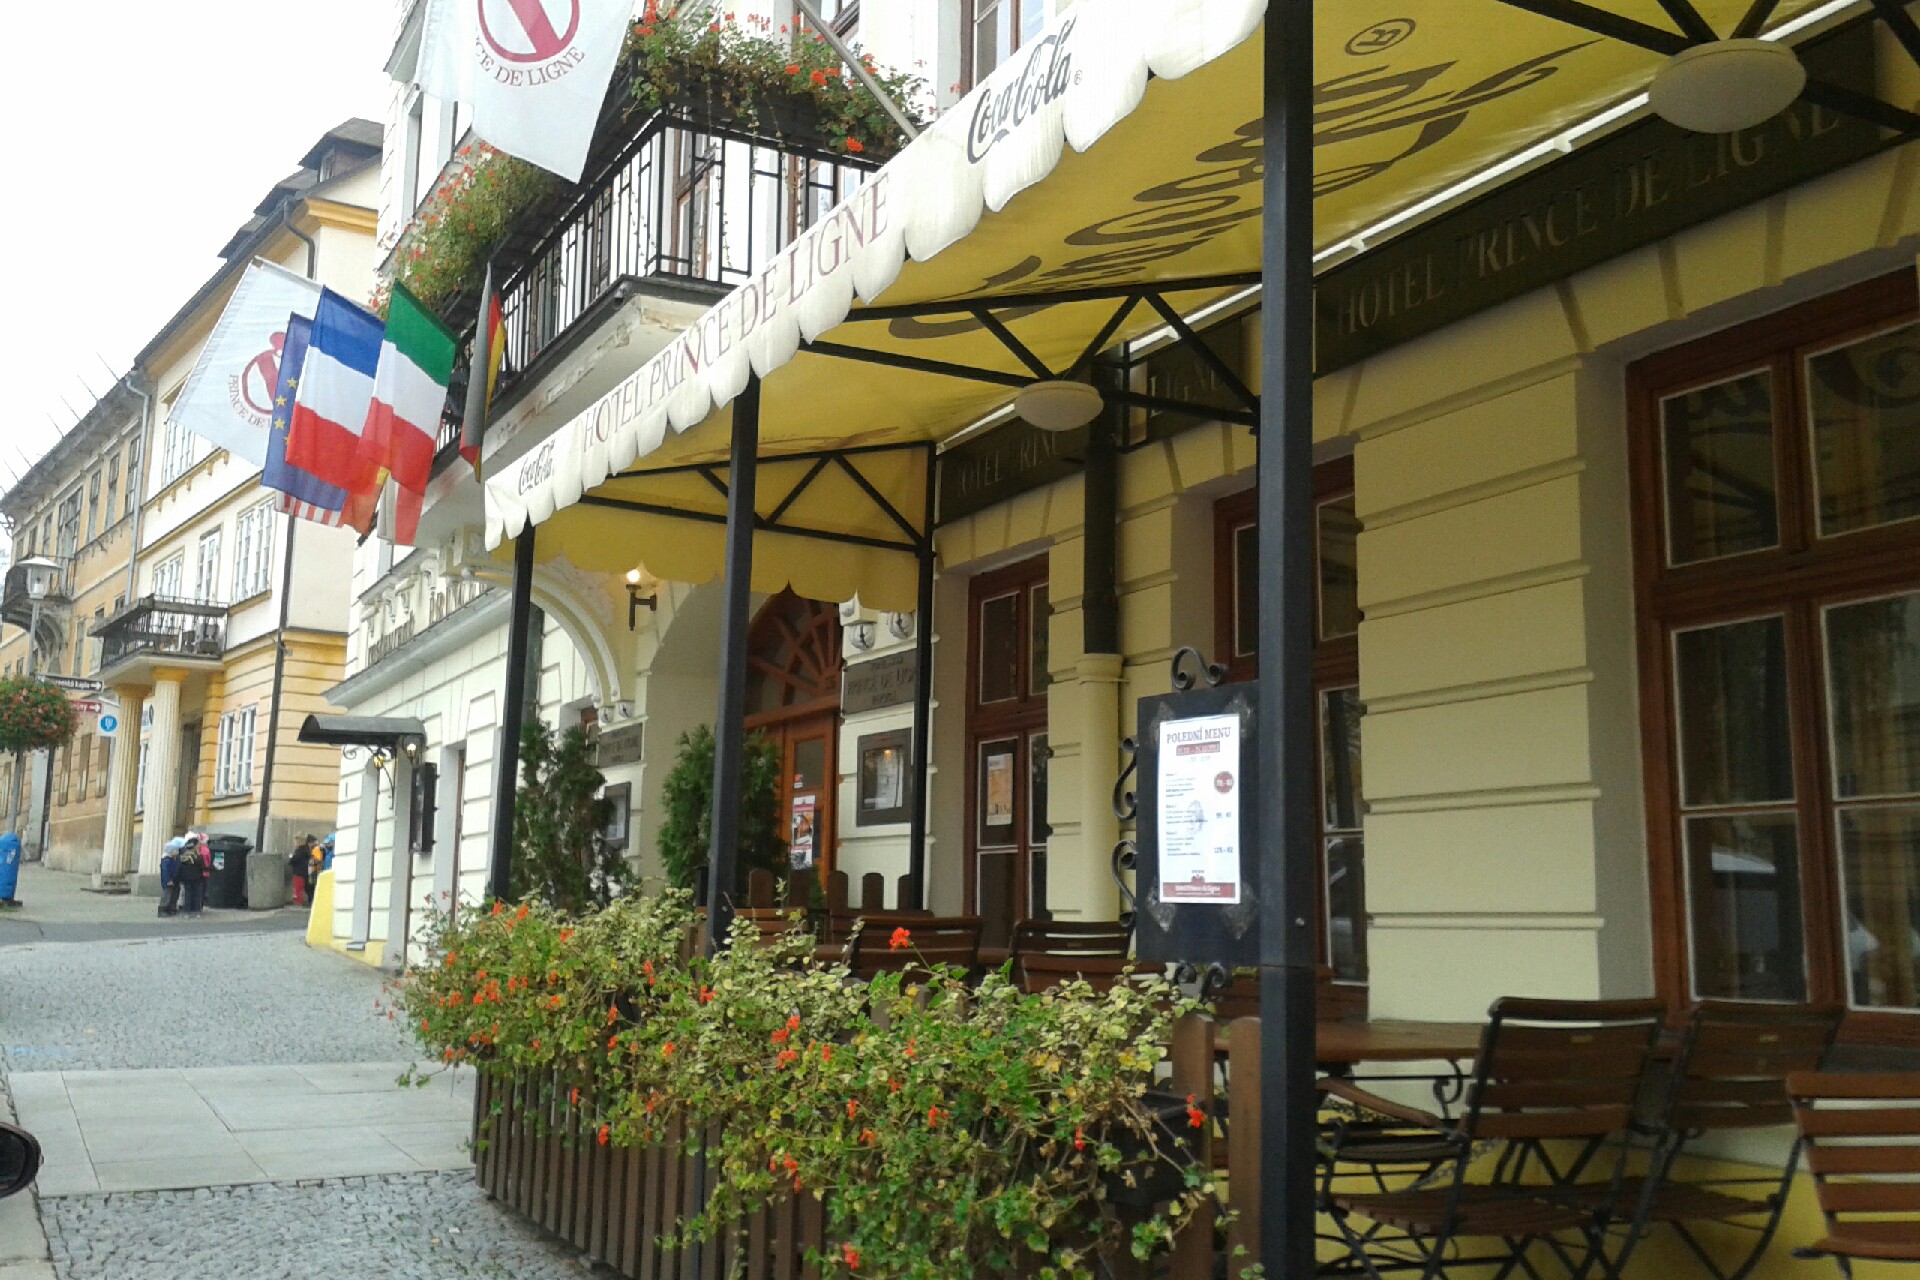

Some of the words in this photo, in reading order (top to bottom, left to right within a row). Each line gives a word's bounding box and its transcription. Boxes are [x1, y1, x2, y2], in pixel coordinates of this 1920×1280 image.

[494, 65, 523, 86] DE
[527, 46, 585, 86] LIGNE
[967, 13, 1077, 164] Coca-Cola
[1337, 252, 1445, 338] HOTEL
[1614, 147, 1670, 218] DE
[583, 373, 643, 452] HOTEL
[648, 301, 732, 407] PRINCE
[739, 262, 777, 342] DE
[788, 171, 890, 306] LIGNE
[228, 374, 249, 419] PRINCE
[248, 415, 265, 429] DE
[1166, 725, 1203, 744] POLEDNÍ
[1205, 726, 1232, 740] MENU
